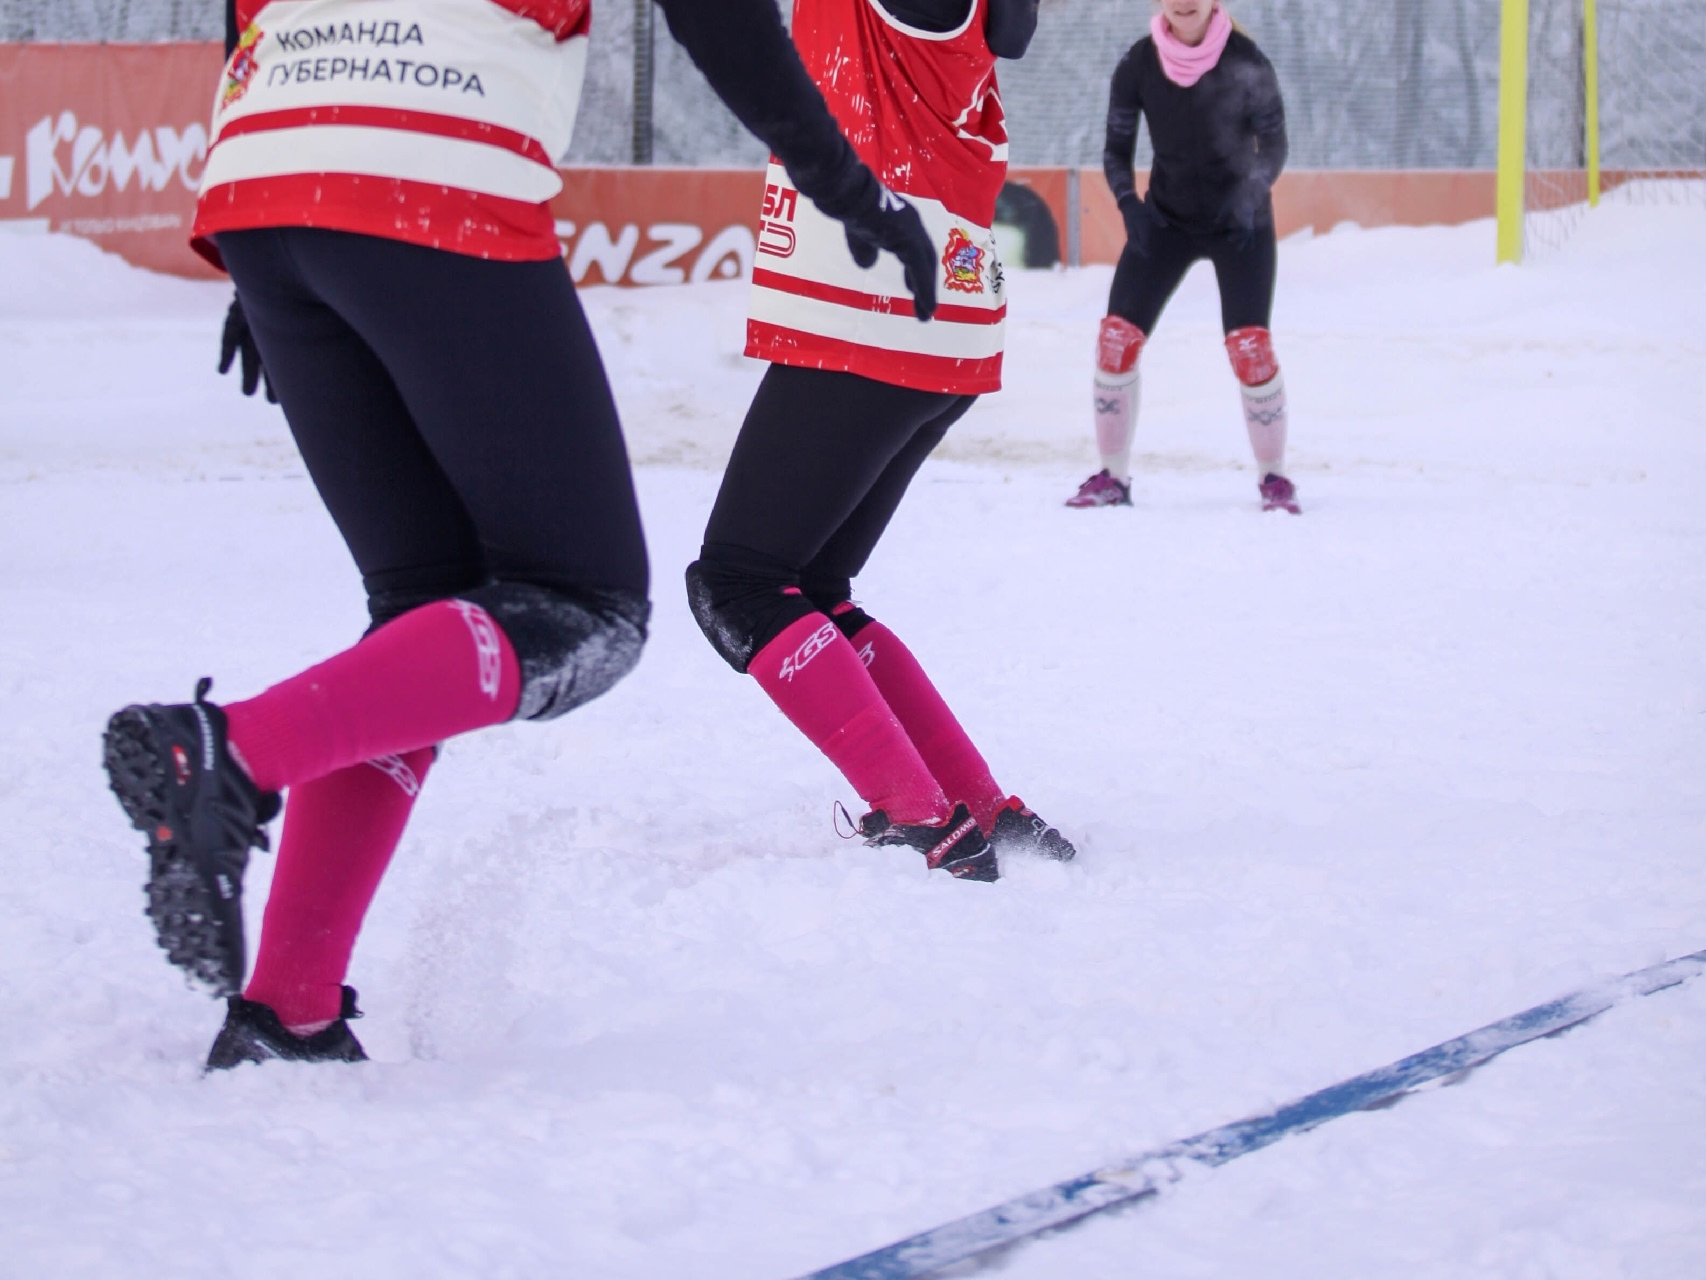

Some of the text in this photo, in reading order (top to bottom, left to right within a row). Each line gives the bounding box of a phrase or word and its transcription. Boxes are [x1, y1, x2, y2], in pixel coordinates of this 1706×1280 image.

[275, 19, 424, 52] КОМАНДА
[267, 57, 486, 97] ГУБЕРНАТОРА
[932, 816, 978, 859] SALOMO
